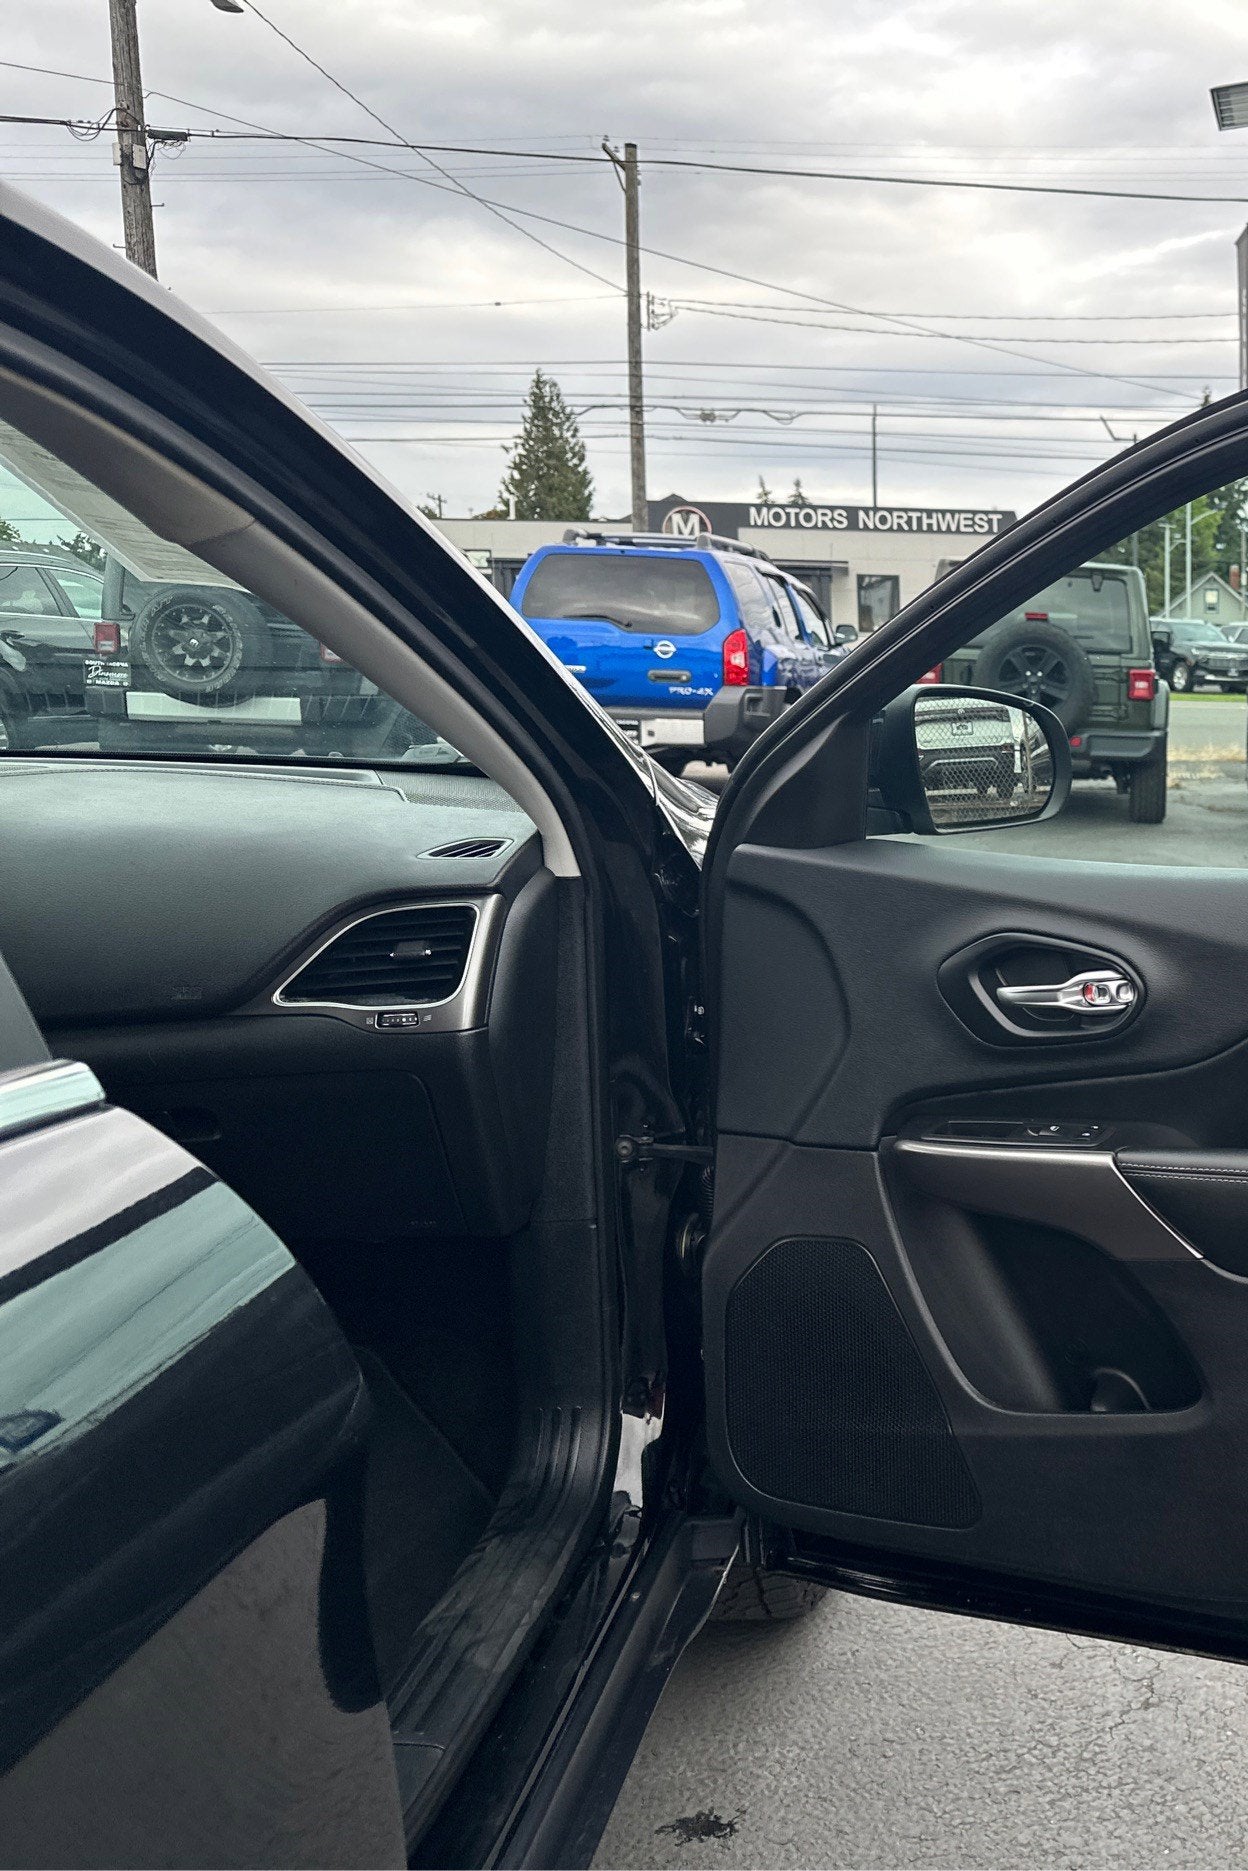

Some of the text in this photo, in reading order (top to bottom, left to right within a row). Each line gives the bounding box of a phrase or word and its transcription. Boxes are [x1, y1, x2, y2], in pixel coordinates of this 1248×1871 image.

[671, 513, 700, 536] M
[749, 506, 1003, 533] MOTORS NORTHWEST
